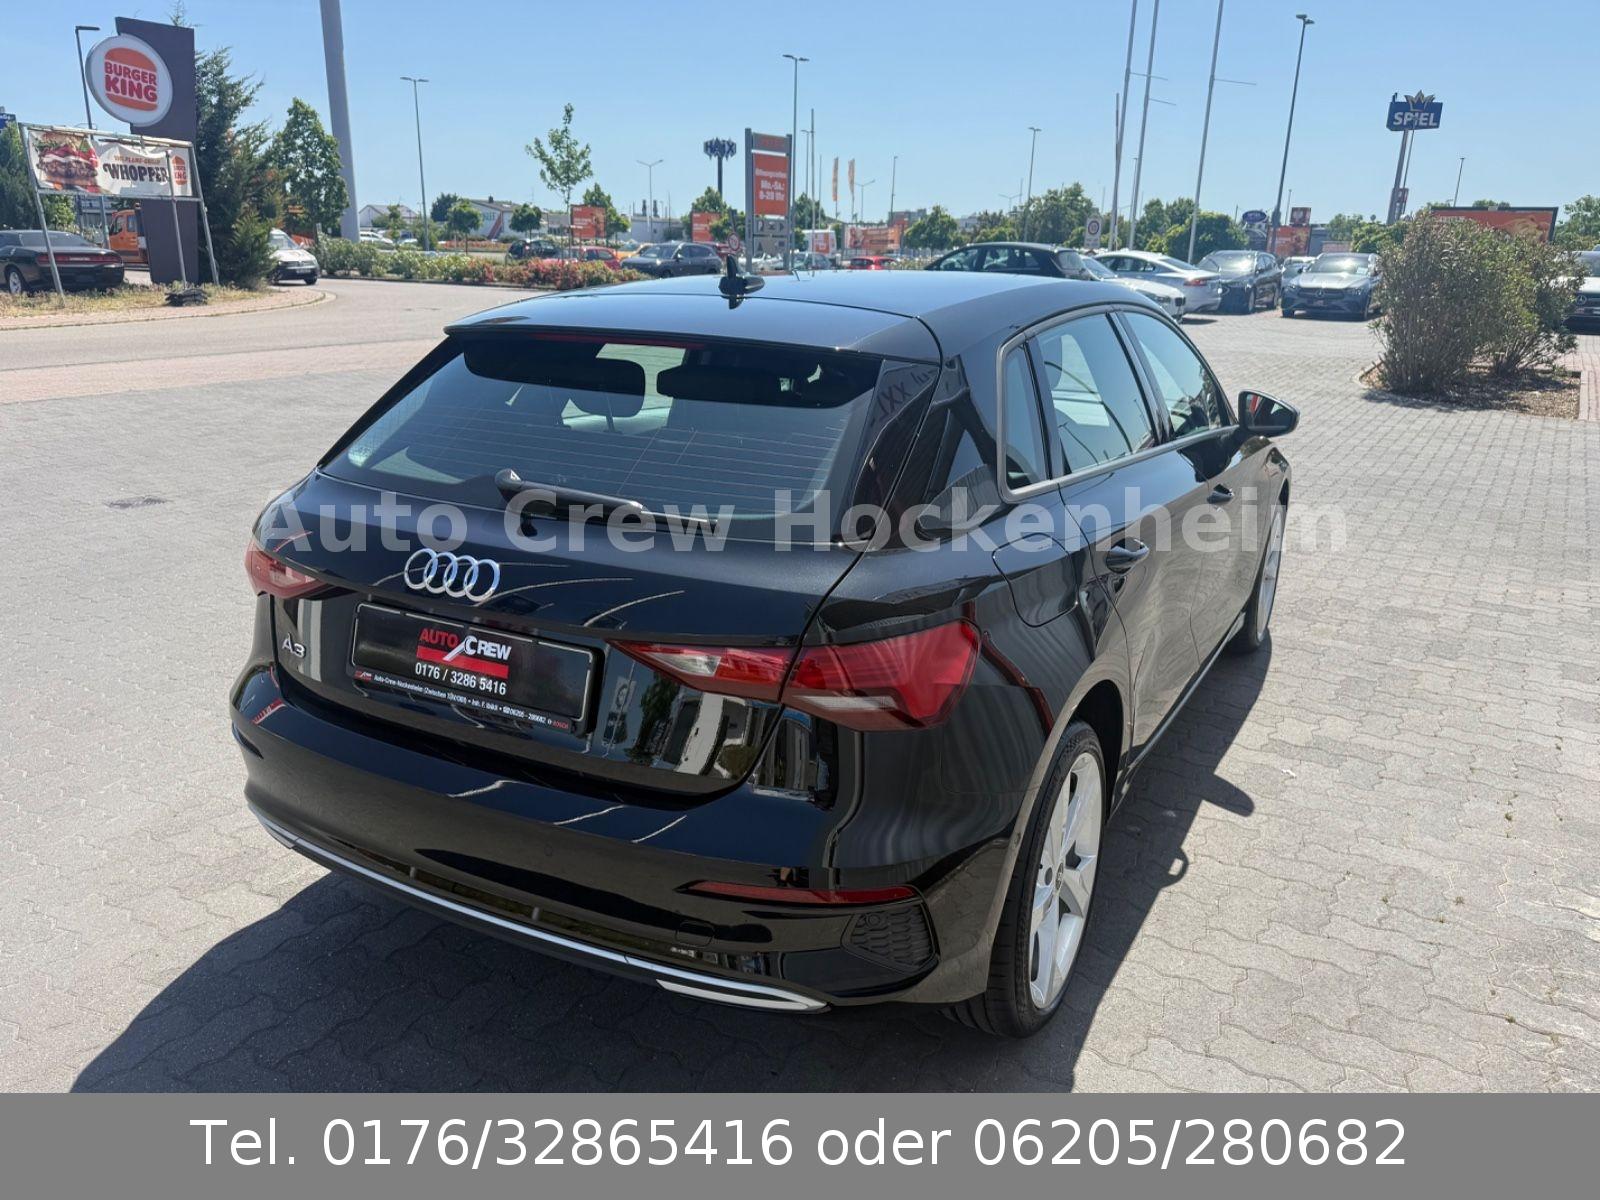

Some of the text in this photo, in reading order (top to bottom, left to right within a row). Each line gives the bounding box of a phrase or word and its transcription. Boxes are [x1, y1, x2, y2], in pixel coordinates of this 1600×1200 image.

[104, 61, 157, 86] BURGER
[104, 74, 158, 103] KING
[1393, 111, 1438, 127] SPIEL
[102, 163, 168, 183] WHOPPER
[281, 632, 306, 658] A3
[419, 628, 512, 661] AUTO CREW
[415, 662, 507, 695] 0176 / 3286 5416
